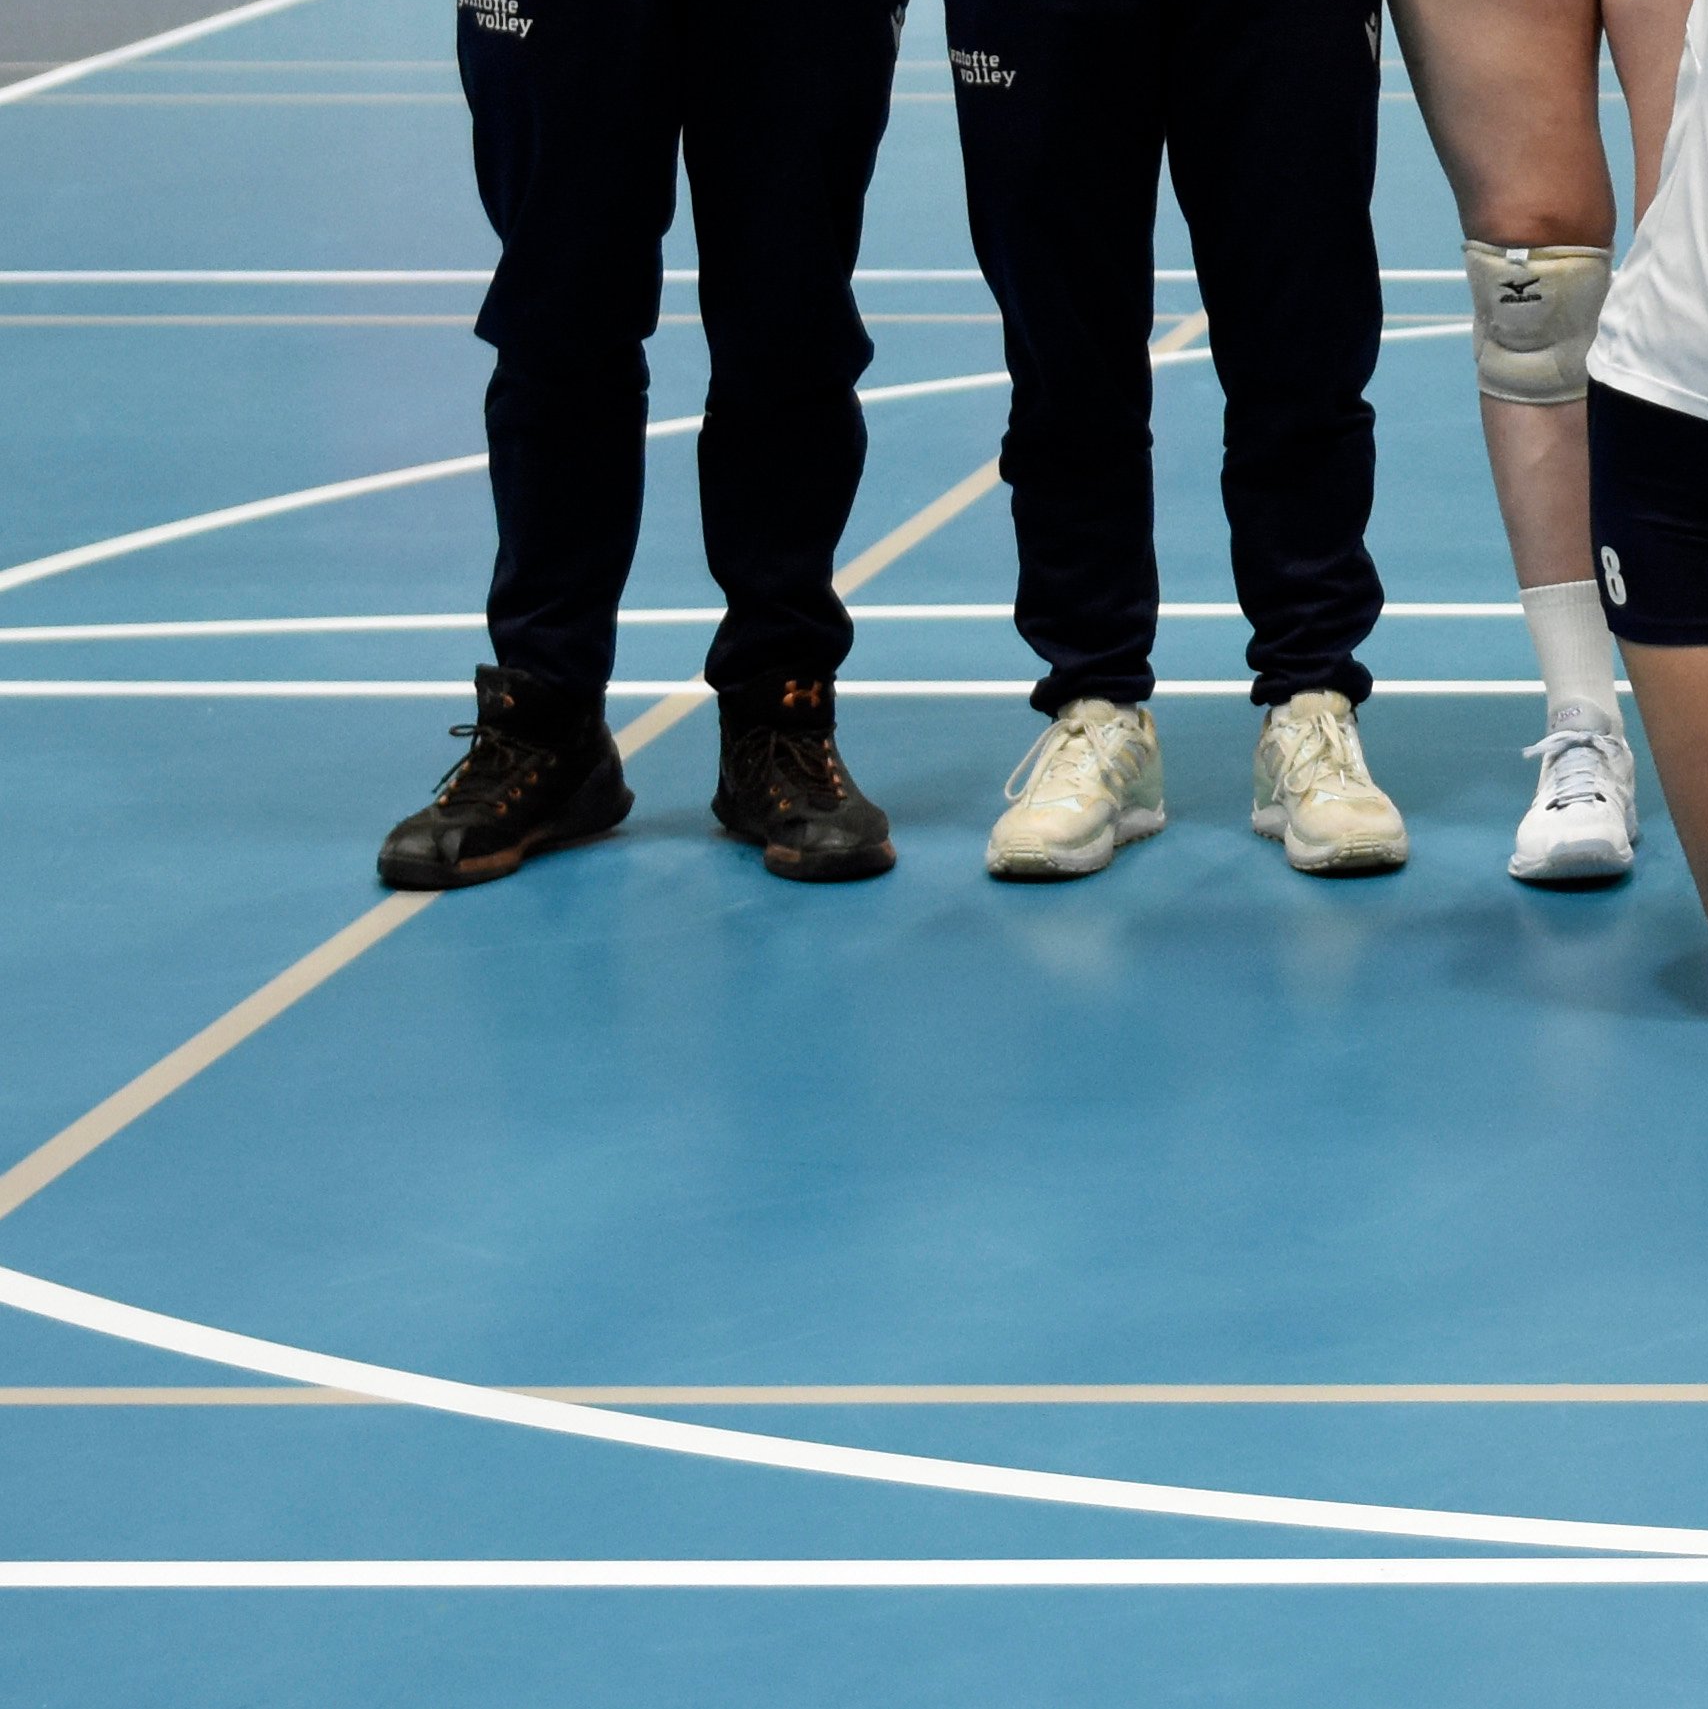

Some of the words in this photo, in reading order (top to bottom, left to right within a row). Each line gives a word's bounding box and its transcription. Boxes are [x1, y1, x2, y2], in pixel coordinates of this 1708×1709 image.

[475, 10, 534, 39] volley
[950, 49, 1000, 70] entofte
[959, 65, 1017, 88] volley
[1600, 545, 1628, 606] 8
